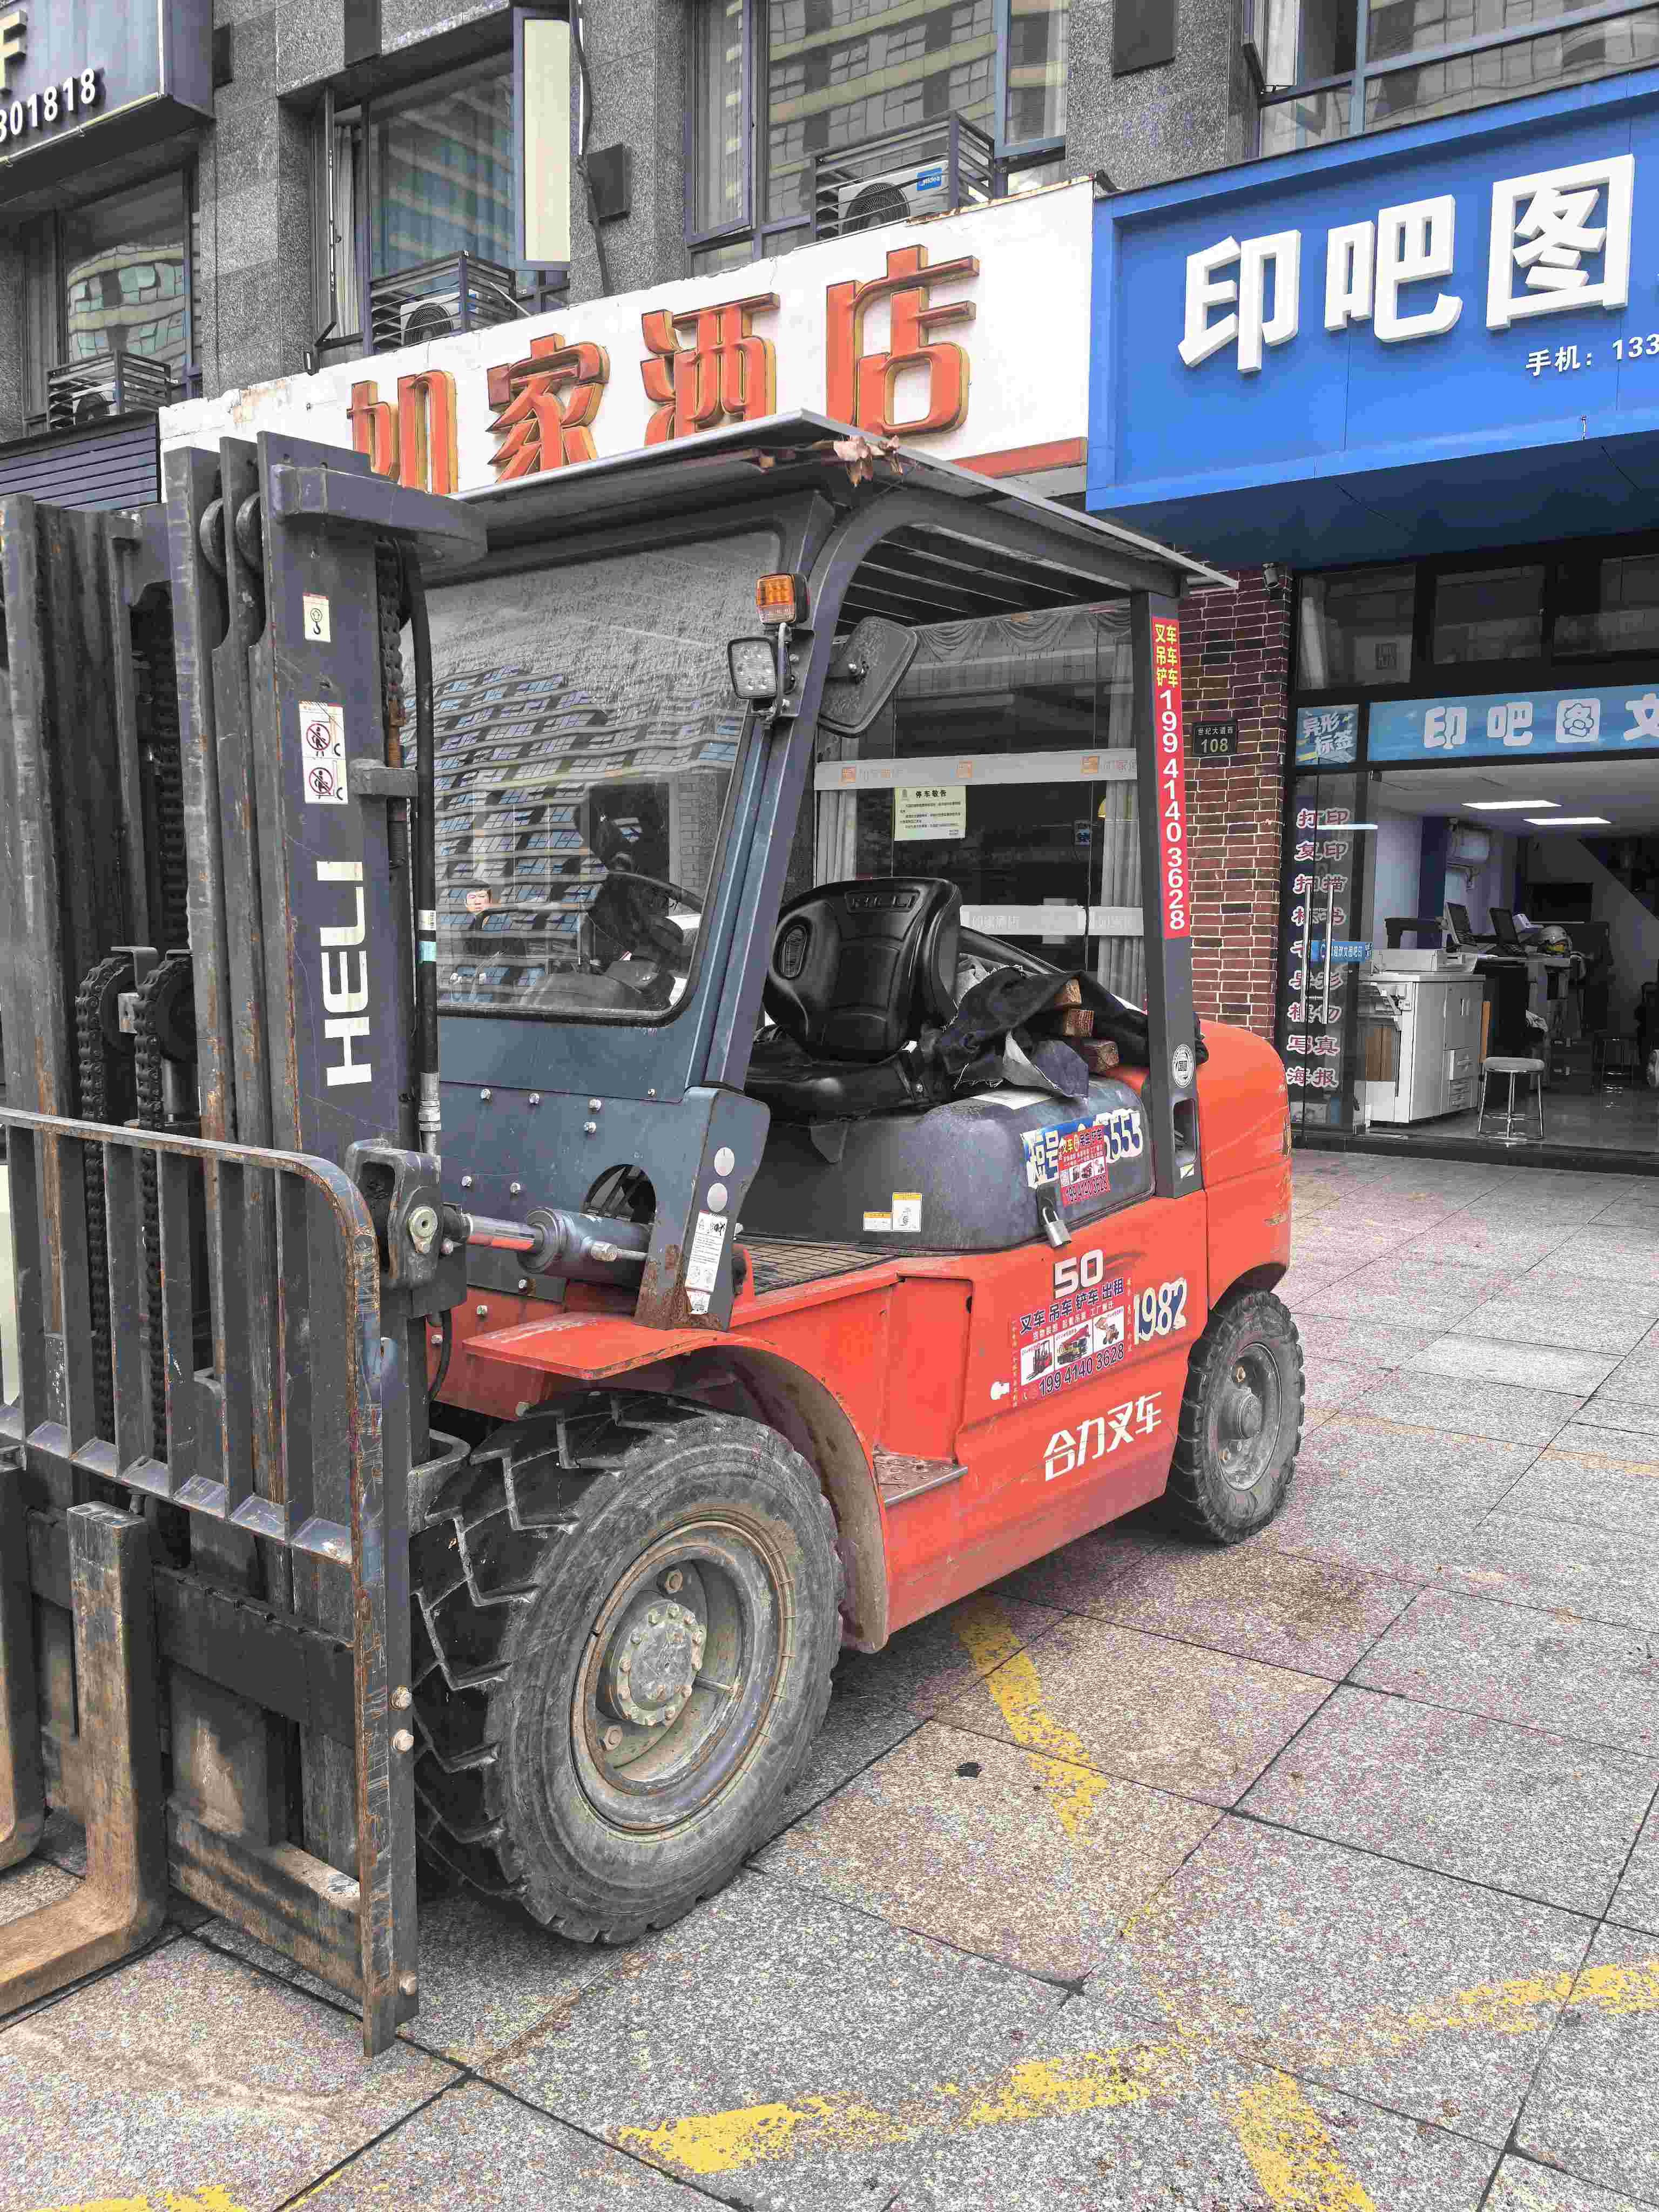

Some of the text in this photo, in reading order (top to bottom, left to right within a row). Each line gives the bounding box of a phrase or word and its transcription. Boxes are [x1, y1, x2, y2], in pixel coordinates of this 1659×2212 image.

[1178, 153, 1635, 374] 印吧图
[1155, 624, 1177, 644] 叉车
[1156, 646, 1178, 666] 吊车
[1201, 738, 1228, 753] 108
[1297, 808, 1351, 829] 打印
[1294, 840, 1348, 861] 复印
[316, 860, 372, 1087] HELI
[1286, 1035, 1340, 1056] 写真
[1286, 1066, 1339, 1088] 海报
[1054, 1249, 1104, 1299] 50
[1019, 1309, 1046, 1336] 叉车
[1049, 1298, 1072, 1322] 吊车
[1039, 1343, 1124, 1397] 199 4140 3628
[1043, 1391, 1162, 1482] 合力叉车
